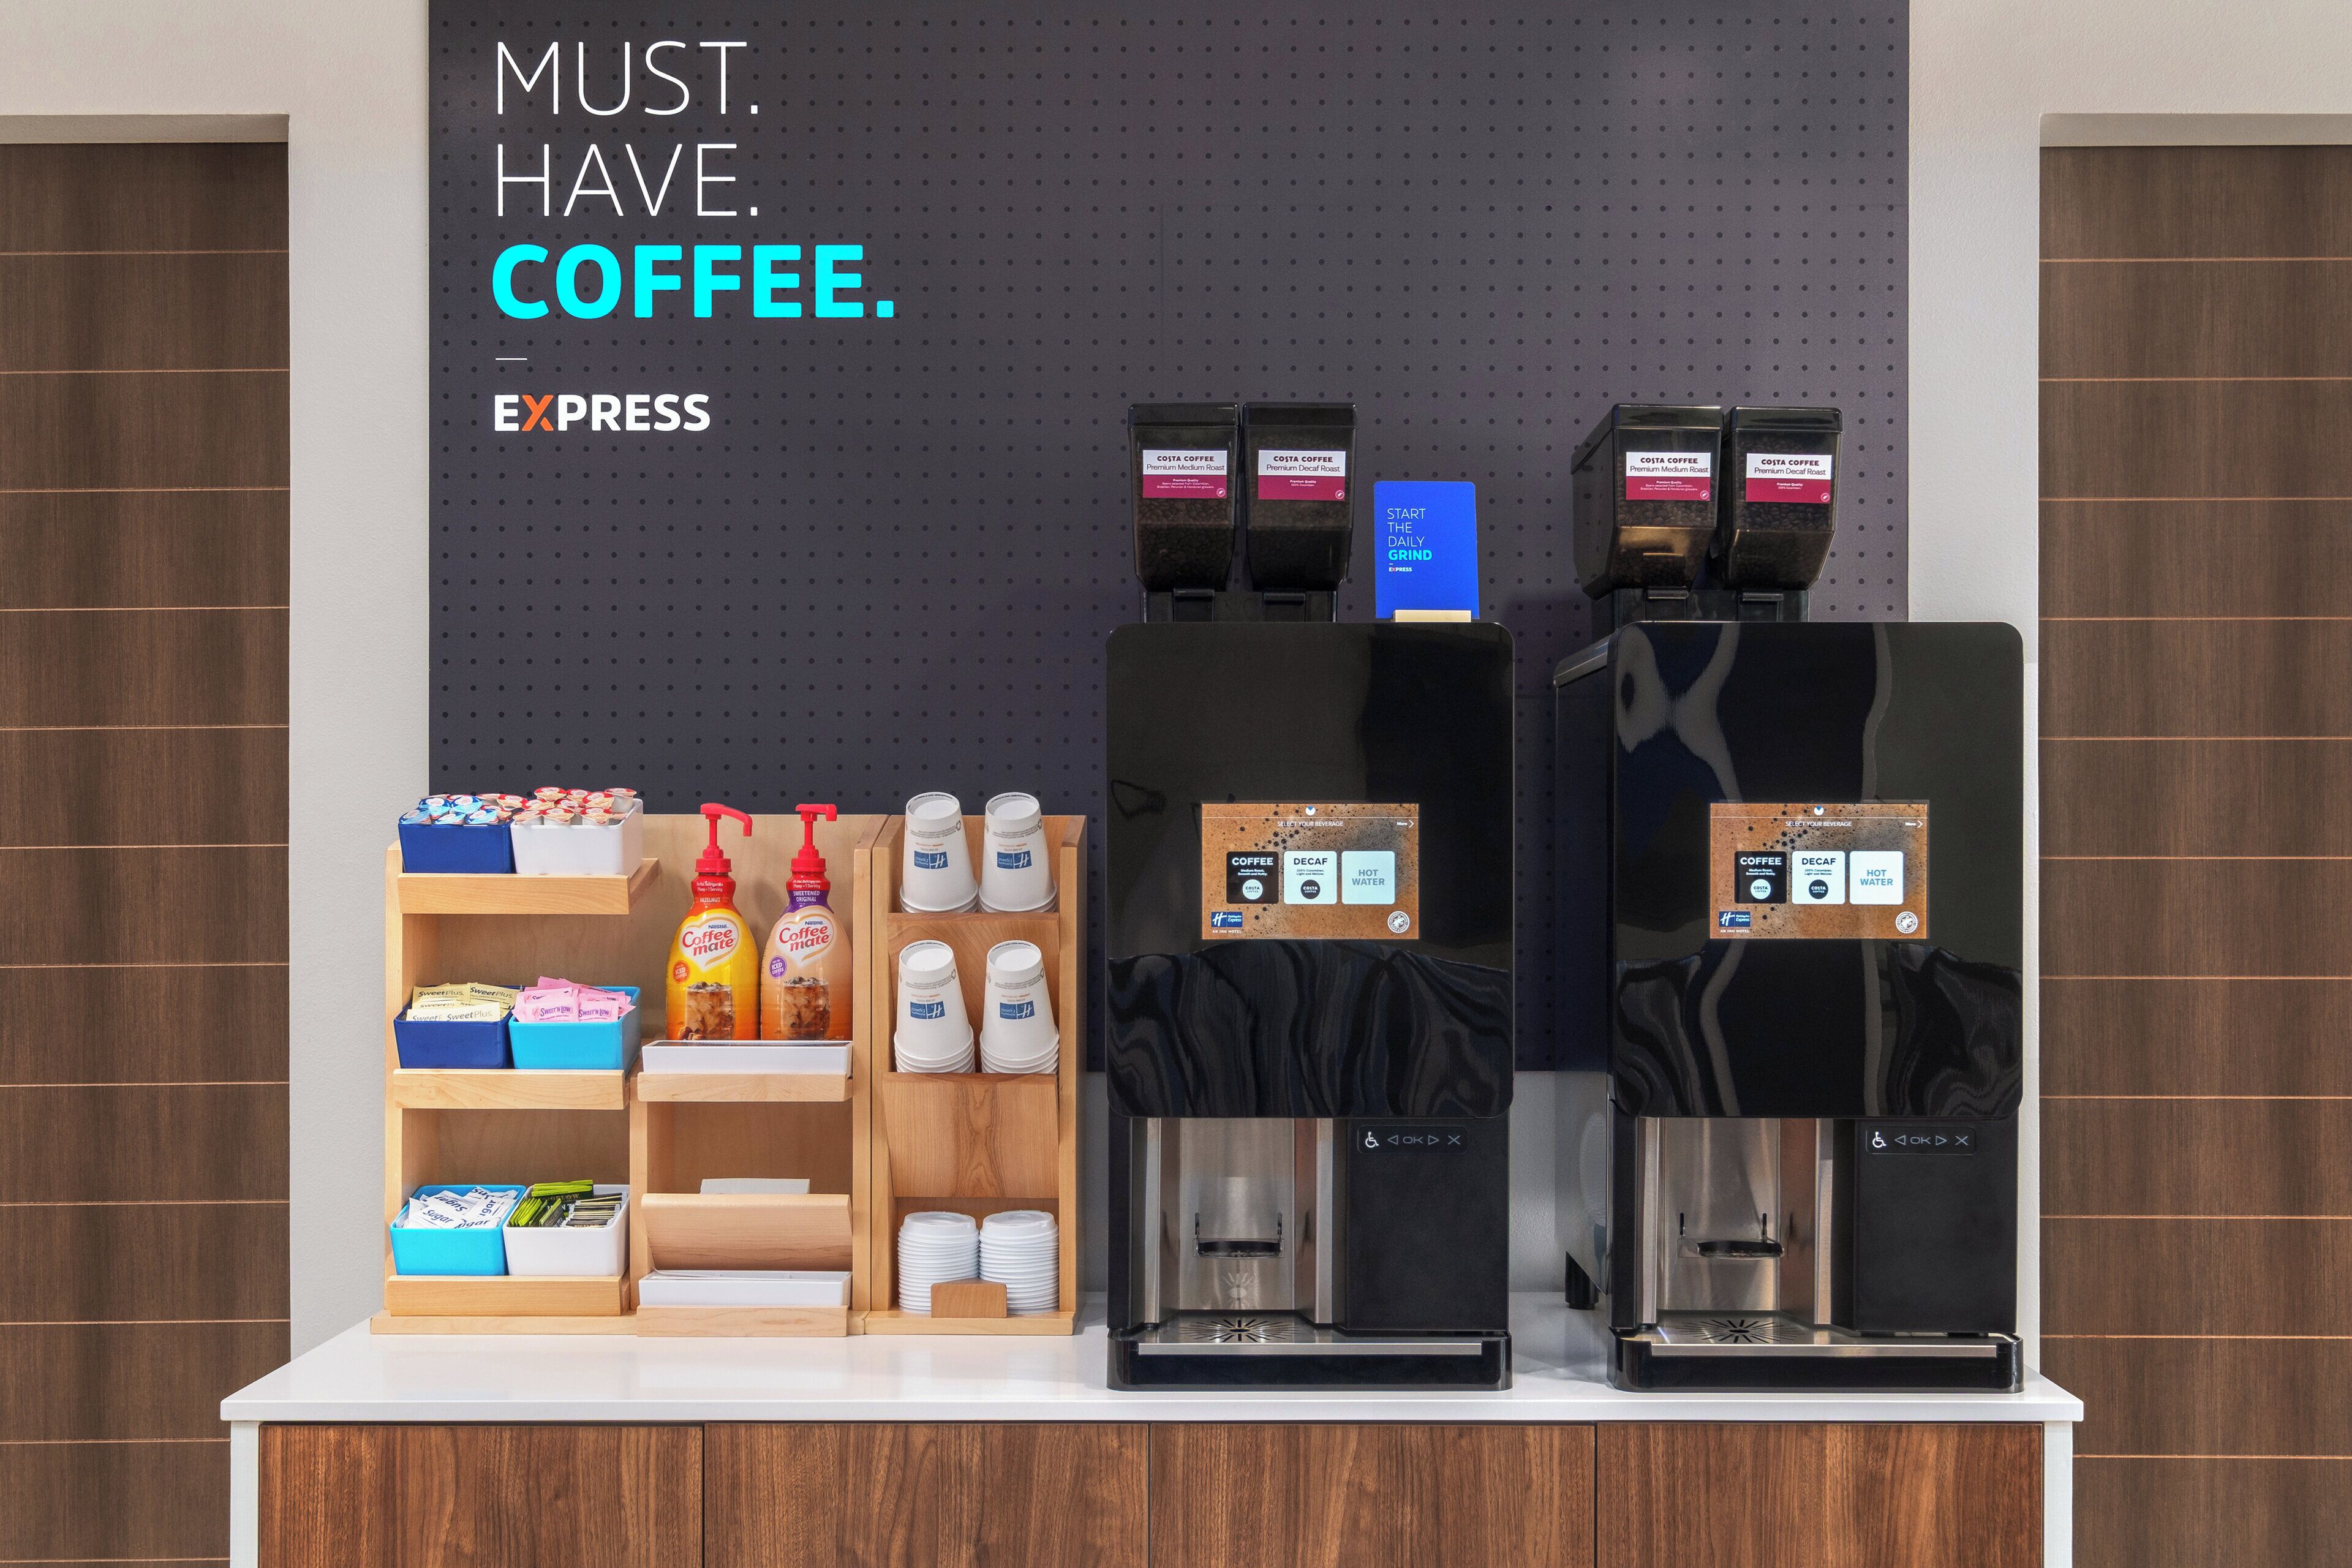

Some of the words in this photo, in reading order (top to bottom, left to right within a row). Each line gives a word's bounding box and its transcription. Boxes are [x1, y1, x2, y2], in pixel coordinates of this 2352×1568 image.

[497, 41, 758, 116] MUST.
[497, 143, 758, 217] HAVE.
[492, 244, 894, 319] COFFEE.
[495, 394, 710, 432] EXPRESS
[1387, 508, 1426, 519] START
[1387, 522, 1412, 533] THE
[1389, 536, 1425, 547] DAILY
[1388, 549, 1432, 560] GRIND
[682, 929, 733, 948] Coffee
[779, 925, 828, 943] Coffee
[790, 934, 829, 952] mate
[693, 938, 734, 956] mate
[423, 1210, 454, 1223] Sugar
